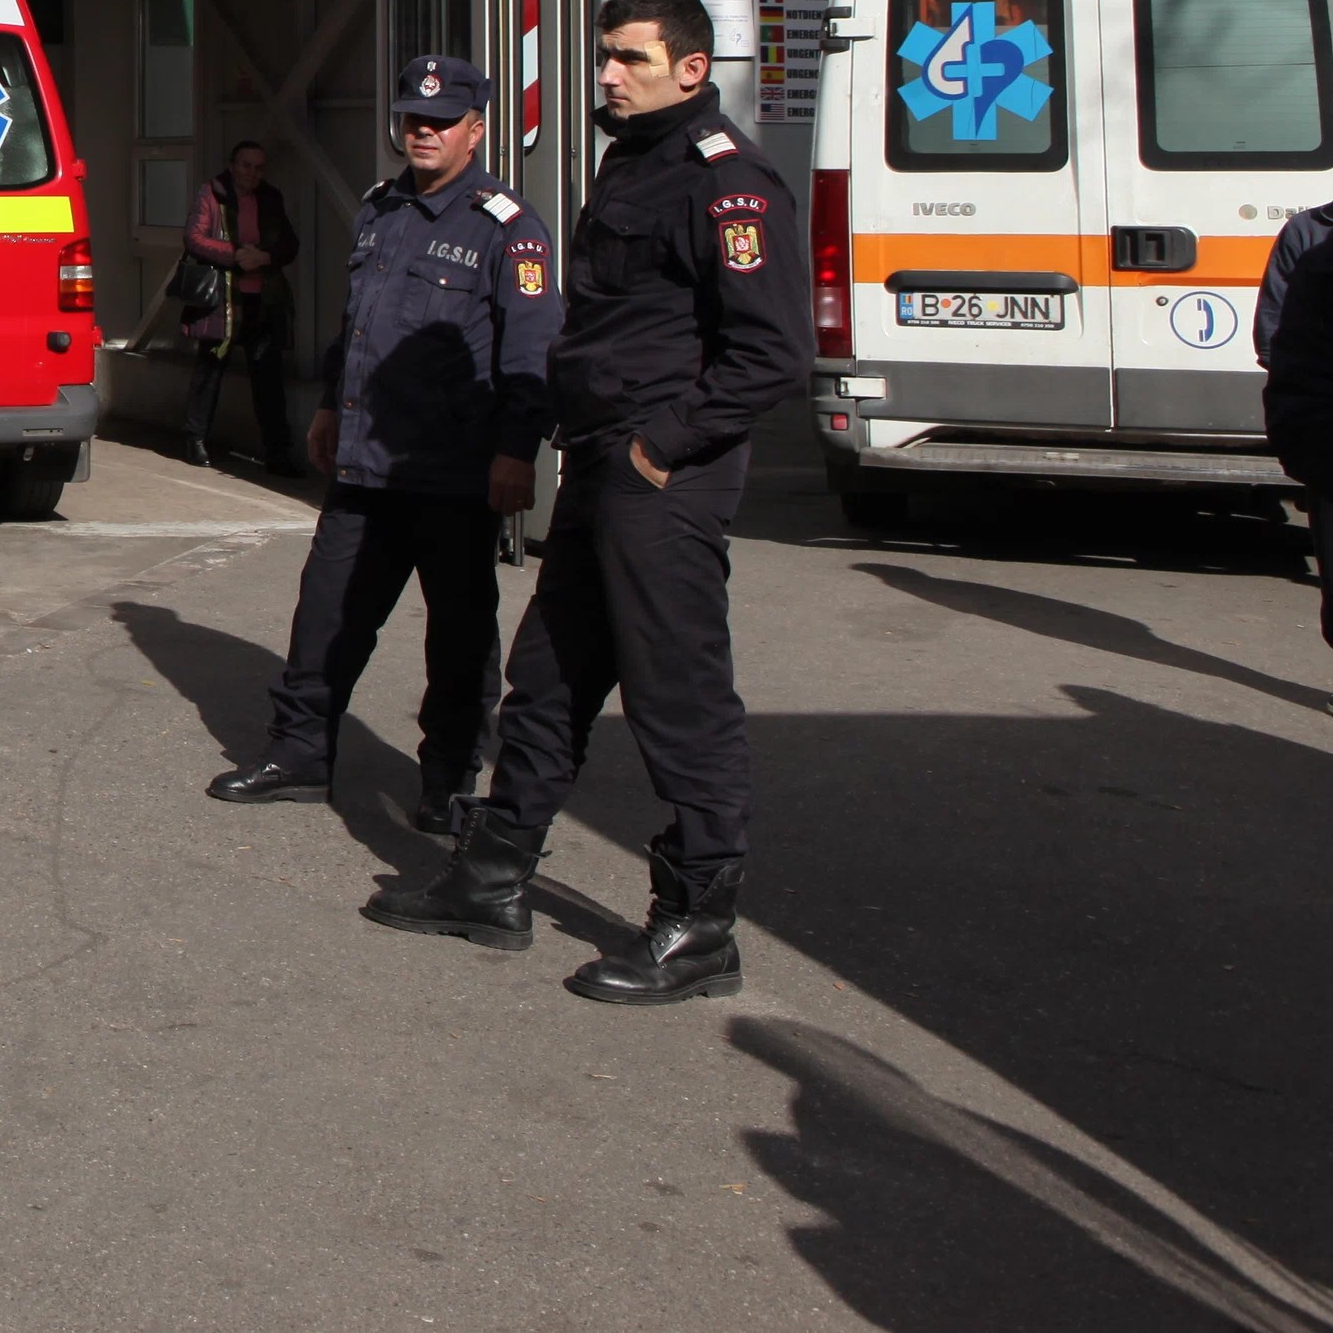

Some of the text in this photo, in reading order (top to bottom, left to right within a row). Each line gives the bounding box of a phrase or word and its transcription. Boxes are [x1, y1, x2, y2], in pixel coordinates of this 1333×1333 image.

[786, 10, 824, 20] NOTDIEN
[787, 29, 821, 39] EMERGE
[787, 69, 819, 79] URGENC
[787, 89, 817, 99] EMERG
[787, 107, 815, 117] EMERG
[714, 197, 760, 213] I.G.S.U.
[912, 202, 976, 216] IVECO
[427, 240, 478, 268] I.G.S.U.
[901, 294, 1050, 320] RO B 26 JNN
